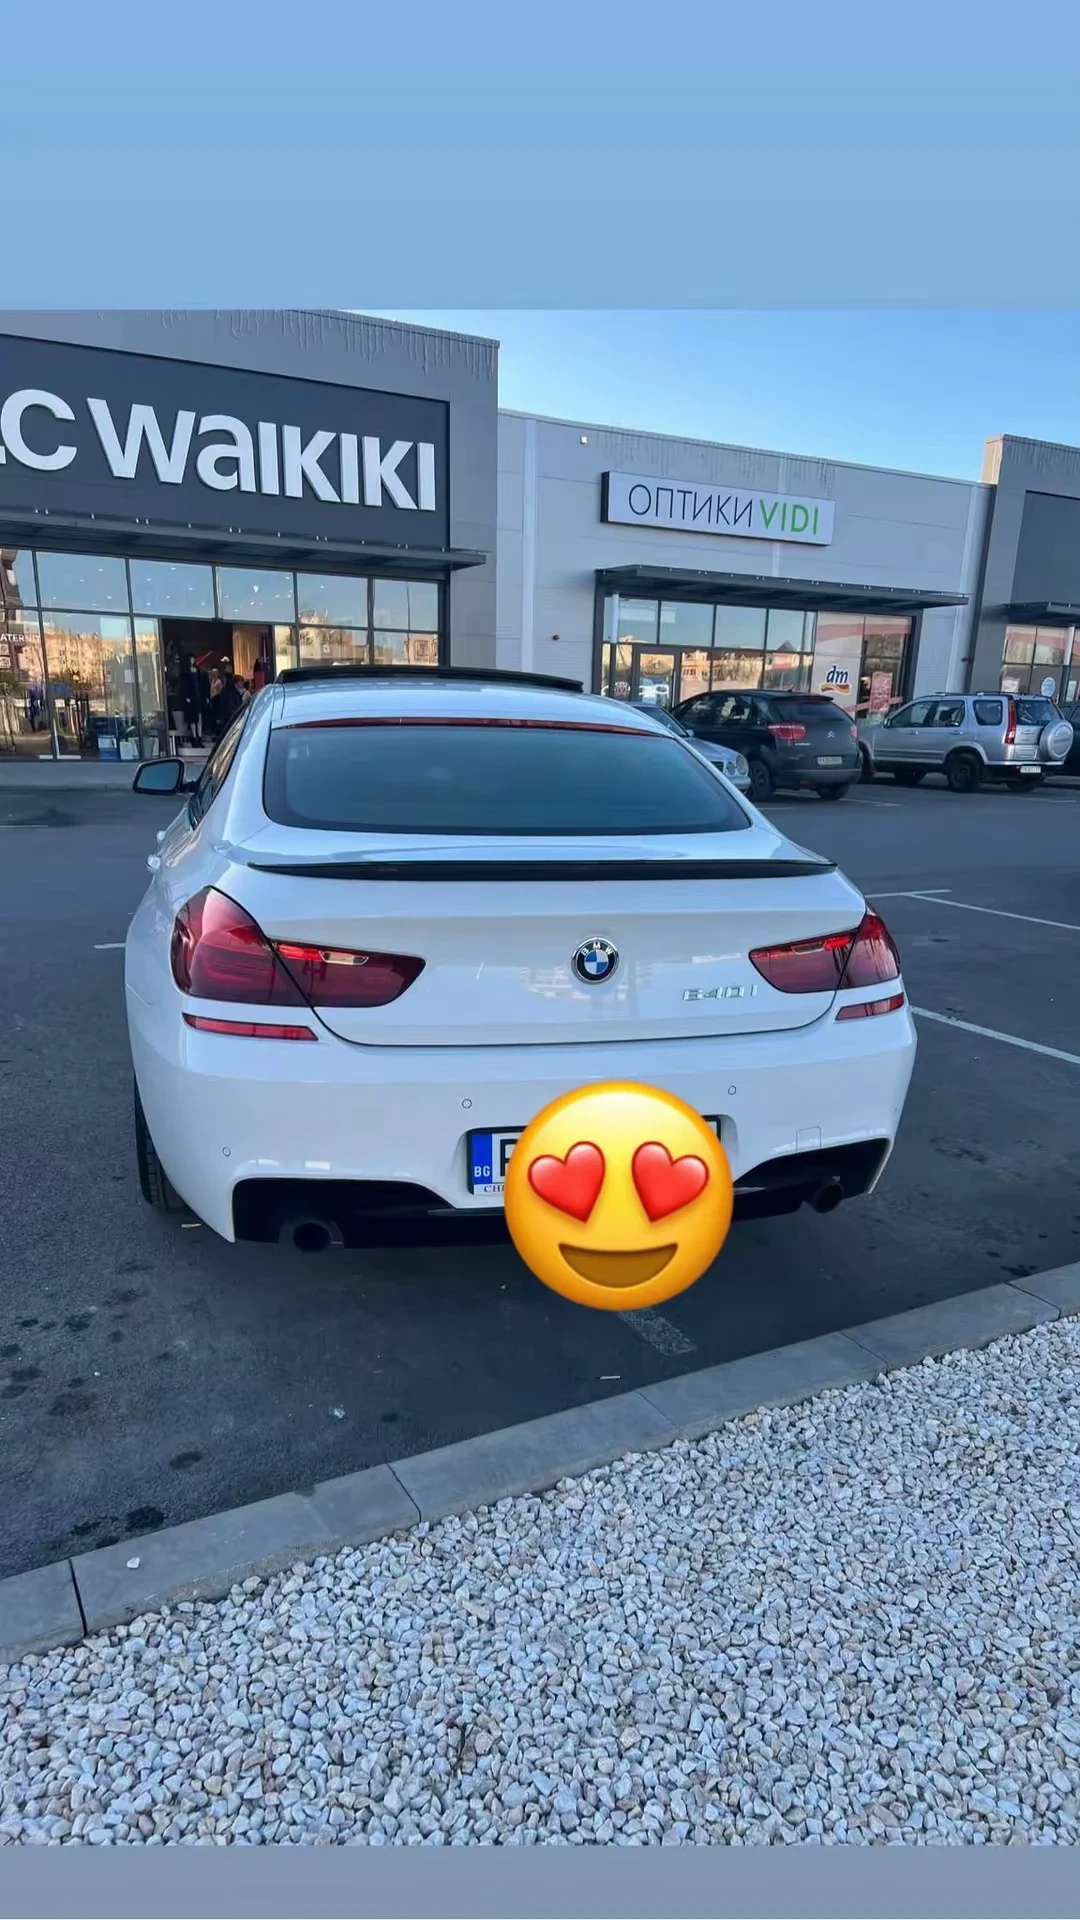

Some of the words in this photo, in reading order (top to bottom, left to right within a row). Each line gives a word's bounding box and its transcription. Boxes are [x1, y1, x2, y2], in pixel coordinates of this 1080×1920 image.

[0, 389, 77, 471] C
[628, 483, 753, 528] ОПТИКИ
[759, 499, 819, 535] VIDI
[826, 665, 849, 684] dm
[580, 941, 613, 956] BMW
[474, 1165, 491, 1178] BG
